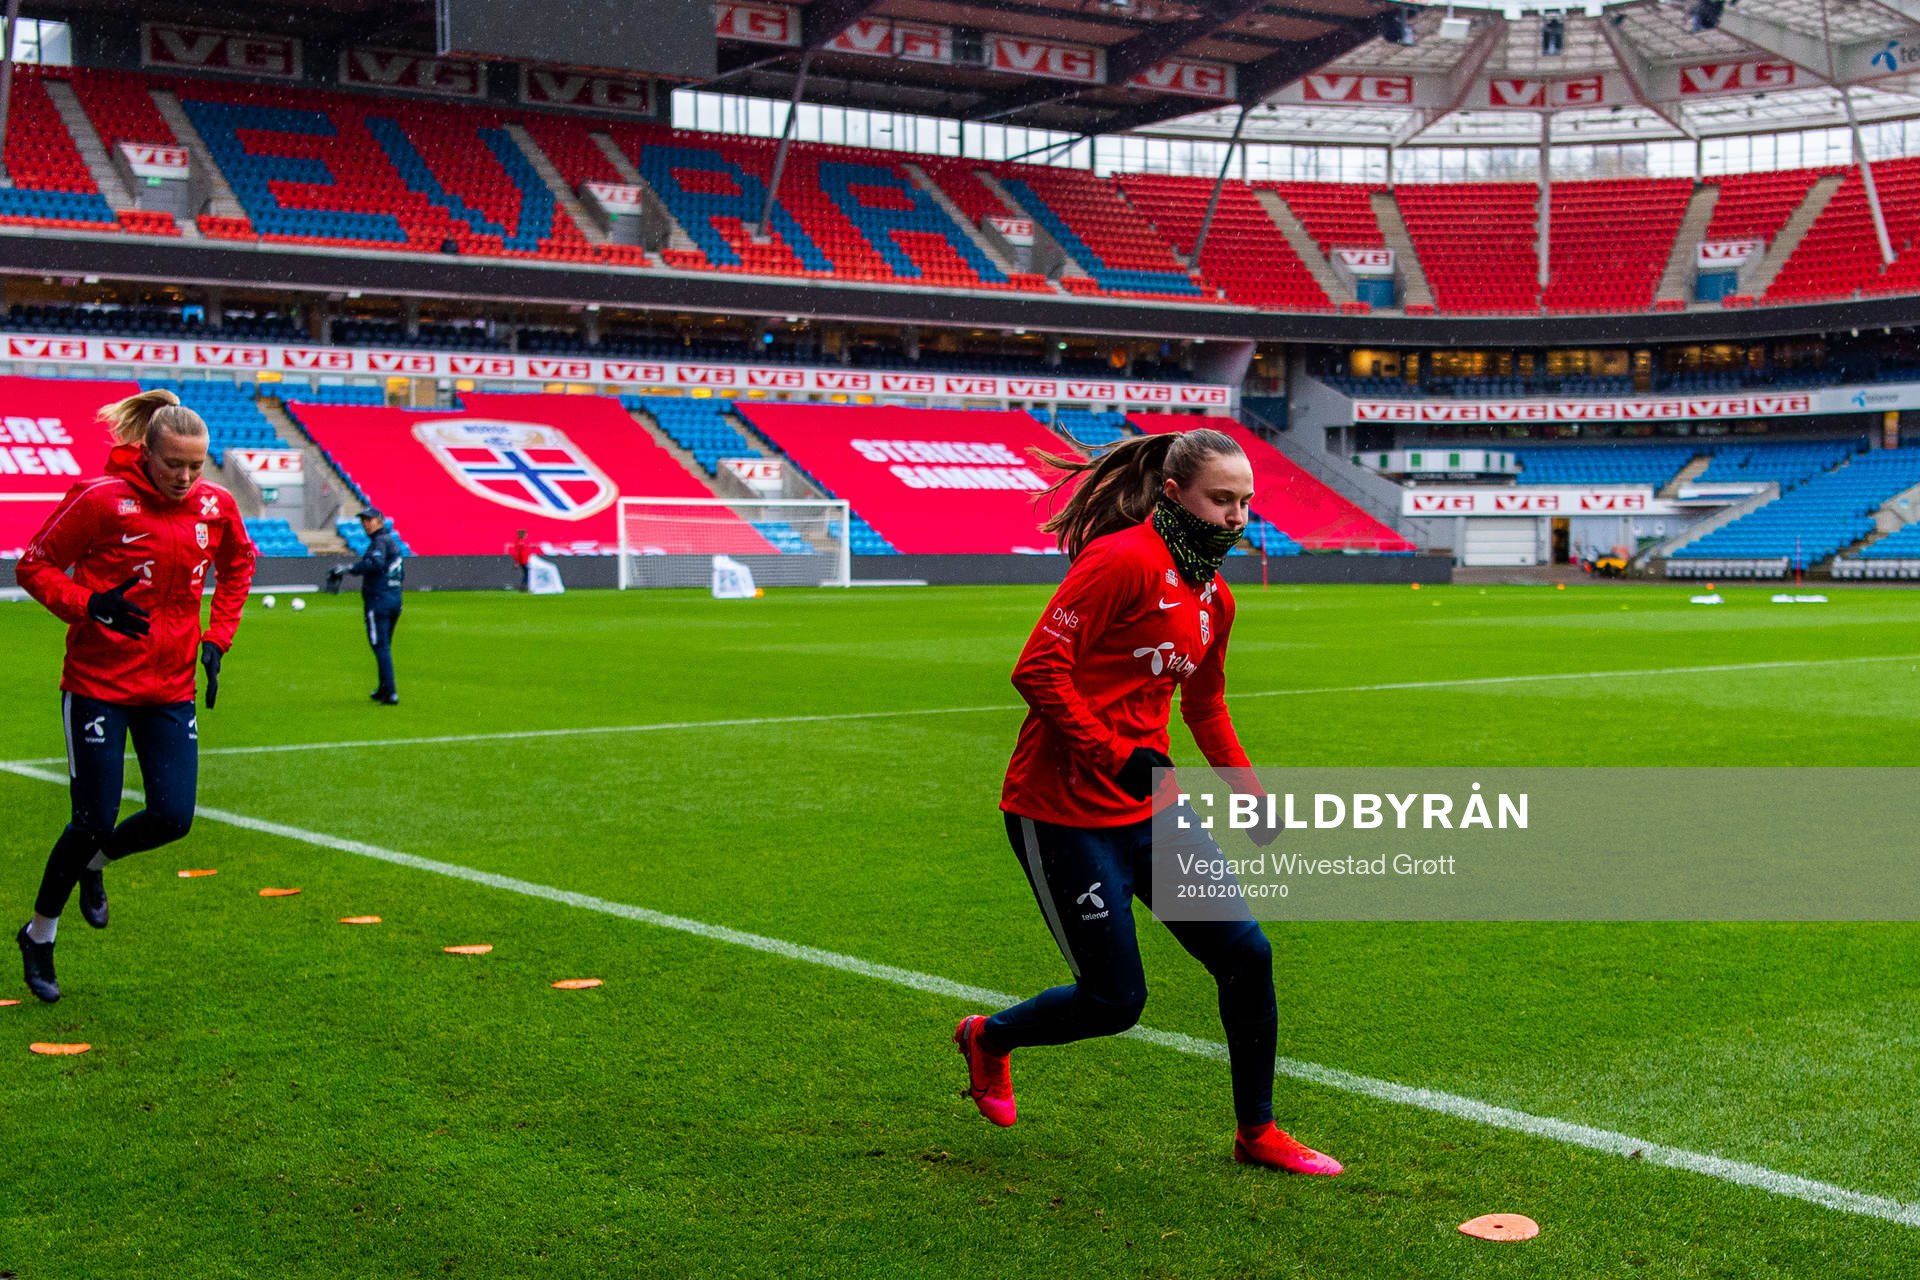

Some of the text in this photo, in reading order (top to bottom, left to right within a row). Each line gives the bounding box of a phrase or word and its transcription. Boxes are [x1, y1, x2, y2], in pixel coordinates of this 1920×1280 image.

[157, 30, 286, 72] VG
[1000, 41, 1091, 80] VG
[354, 51, 473, 93] VG
[1141, 61, 1224, 94] VG
[1684, 63, 1791, 91] VG
[532, 72, 642, 108] VG
[1308, 75, 1410, 101] VG
[1492, 76, 1600, 105] VG
[121, 147, 185, 167] VG
[588, 187, 638, 204] VG
[989, 221, 1031, 236] VG
[1341, 252, 1387, 265] VG
[1703, 244, 1754, 257] VG
[10, 339, 1223, 403] VG VG VG VG VG VG VG VG VG VG VG VG VG VG VG VG VG
[1360, 397, 1805, 420] VG VG VG VG VG VG VG
[238, 453, 303, 472] VG
[850, 439, 1026, 465] STERKERE
[725, 463, 782, 479] VG
[889, 464, 1051, 490] SAMMEN
[1415, 496, 1642, 510] VG VG VG
[1052, 607, 1079, 628] DNB
[1081, 909, 1109, 921] telenor
